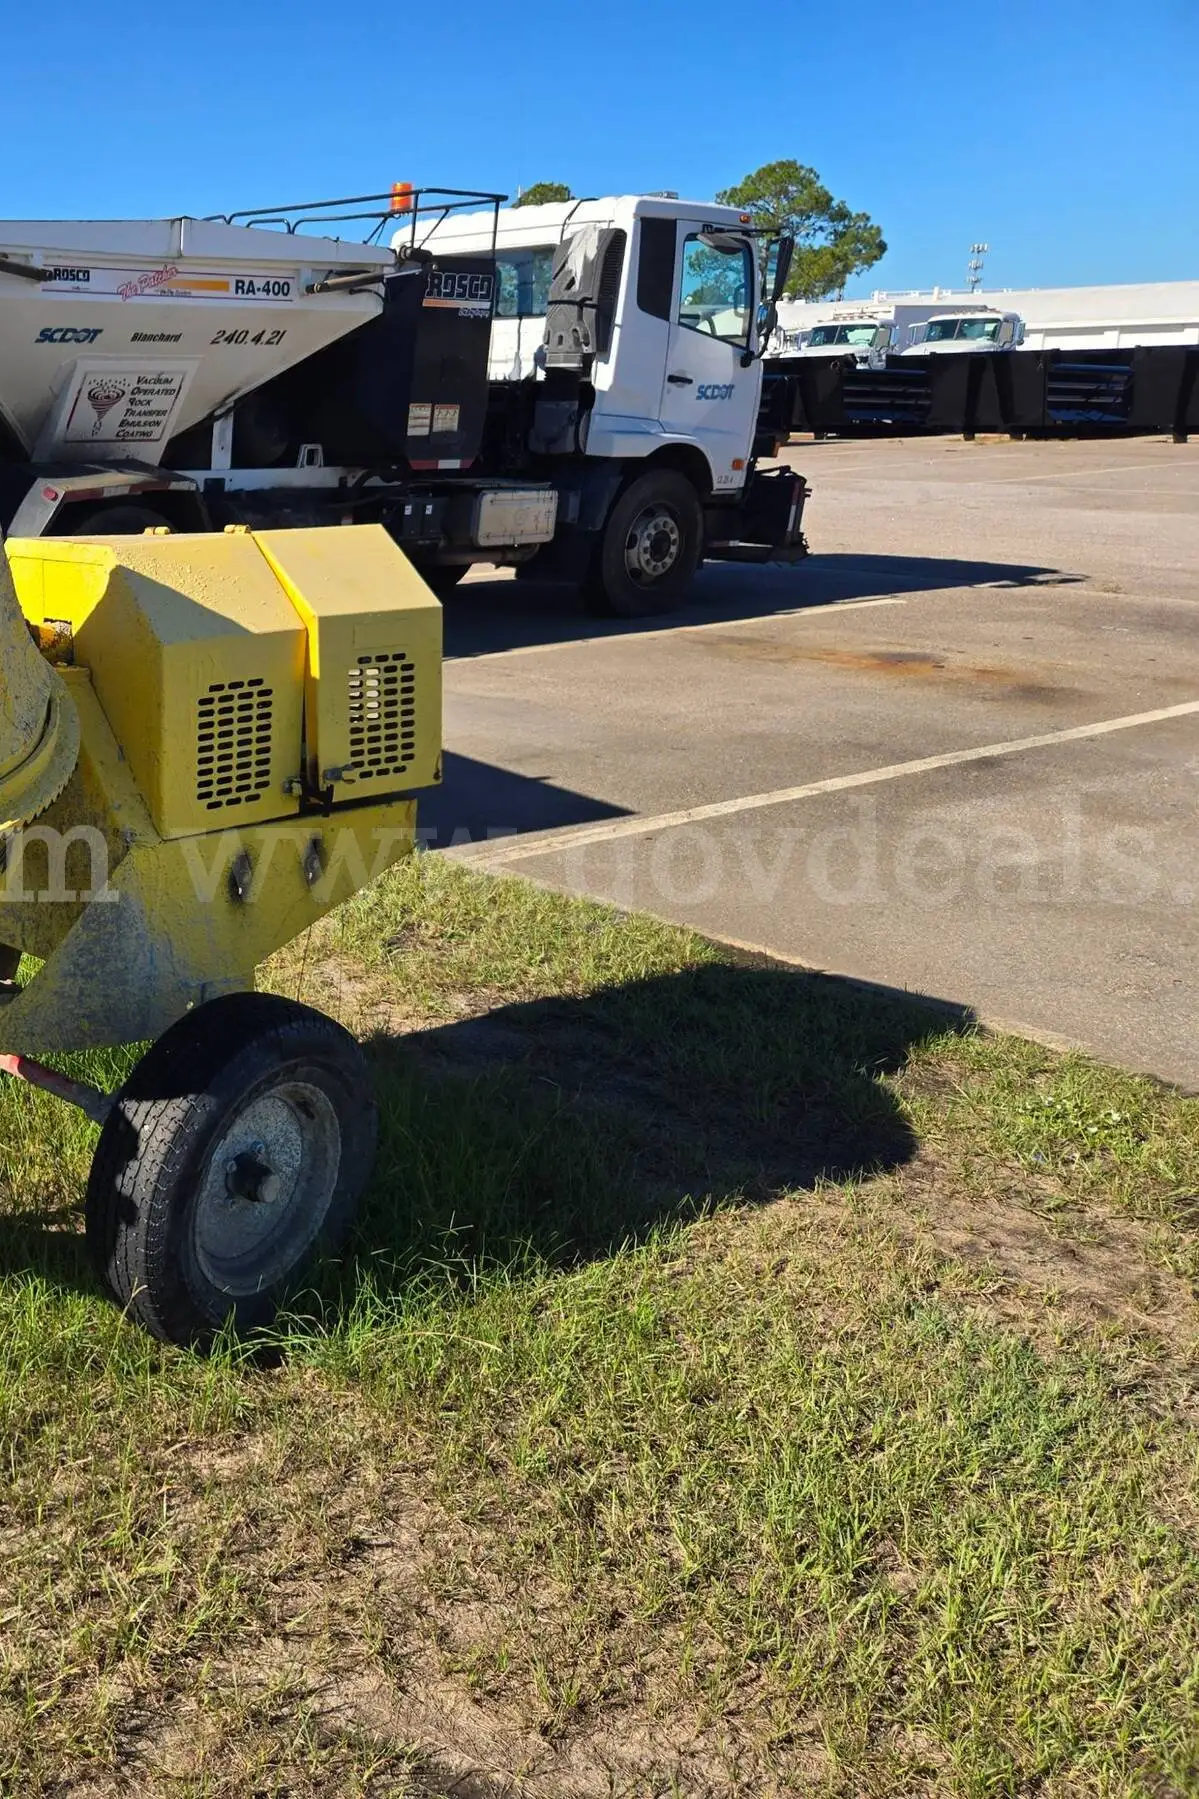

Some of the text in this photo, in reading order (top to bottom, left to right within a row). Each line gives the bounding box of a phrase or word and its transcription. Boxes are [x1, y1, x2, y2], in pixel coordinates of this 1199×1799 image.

[53, 267, 90, 282] ROSCO
[234, 279, 291, 297] RA-400
[425, 271, 494, 300] ROSCO
[34, 327, 104, 344] SCDOT
[129, 331, 183, 343] Blanchard
[209, 329, 287, 346] 240.4.21
[695, 384, 735, 400] SCDOT
